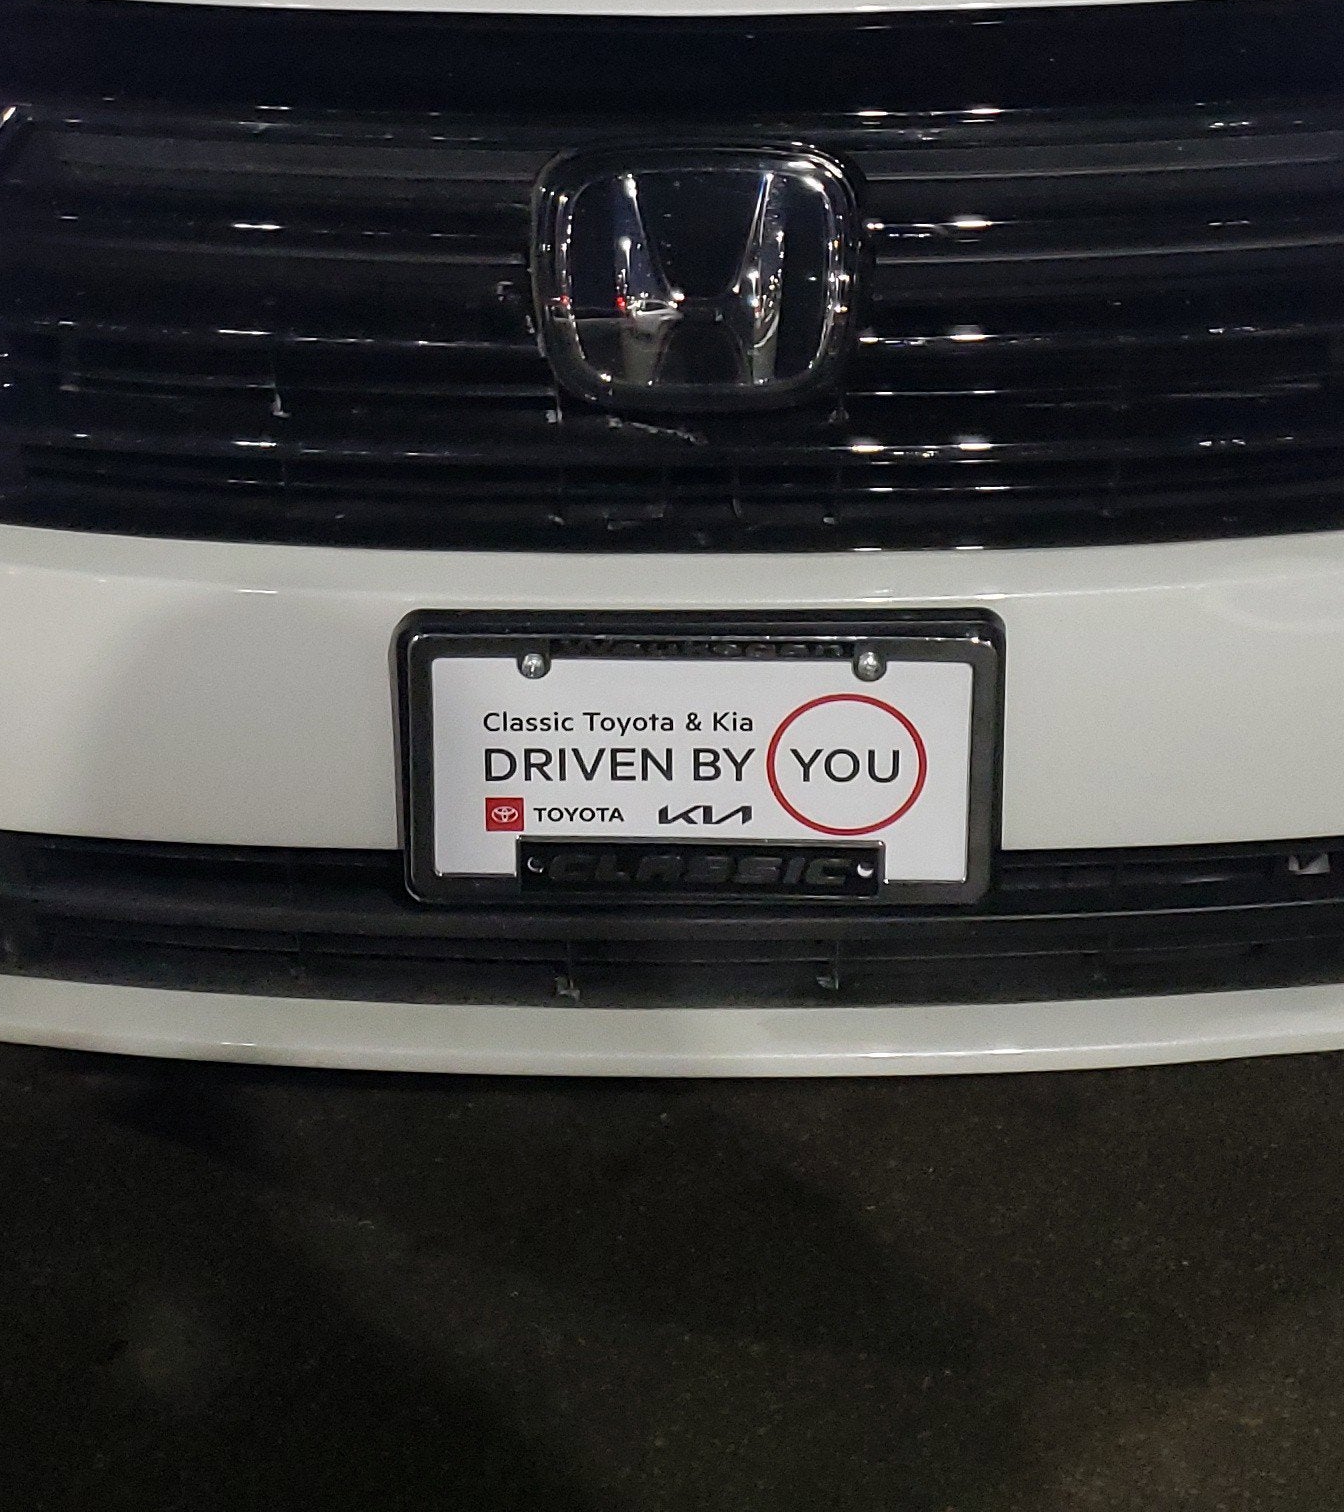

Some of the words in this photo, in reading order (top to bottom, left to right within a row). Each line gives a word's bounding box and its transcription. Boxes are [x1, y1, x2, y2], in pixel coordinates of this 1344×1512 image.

[482, 710, 575, 733] Classic
[582, 710, 675, 737] Toyota
[685, 710, 703, 733] &
[712, 710, 754, 733] Kia
[483, 746, 674, 783] DRIVEN
[691, 746, 757, 783] BY
[788, 747, 901, 785] YOU
[532, 806, 626, 824] TOYOTA
[548, 853, 853, 885] CLASSIC
